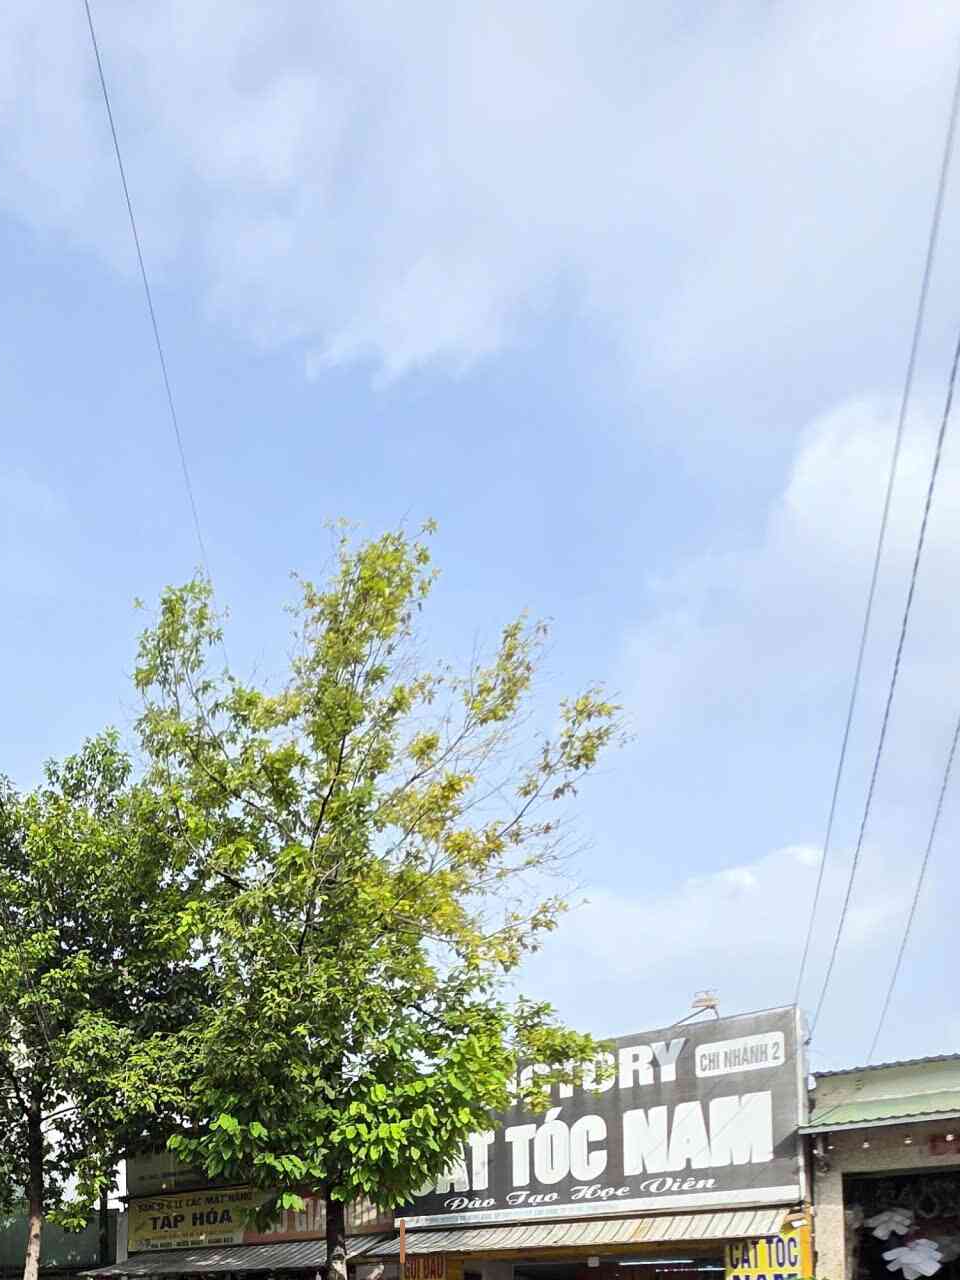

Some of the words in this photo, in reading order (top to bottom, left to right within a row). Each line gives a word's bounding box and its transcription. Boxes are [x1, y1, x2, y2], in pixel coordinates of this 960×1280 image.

[700, 1052, 721, 1072] CHI
[771, 1042, 780, 1060] 2
[505, 1107, 608, 1187] TÓC
[623, 1090, 775, 1177] NAM
[443, 1196, 496, 1211] Đào
[506, 1190, 559, 1206] Tạo
[570, 1184, 630, 1201] Học
[640, 1177, 717, 1193] Viên
[148, 1216, 185, 1233] TẠP
[192, 1208, 233, 1226] HÓA
